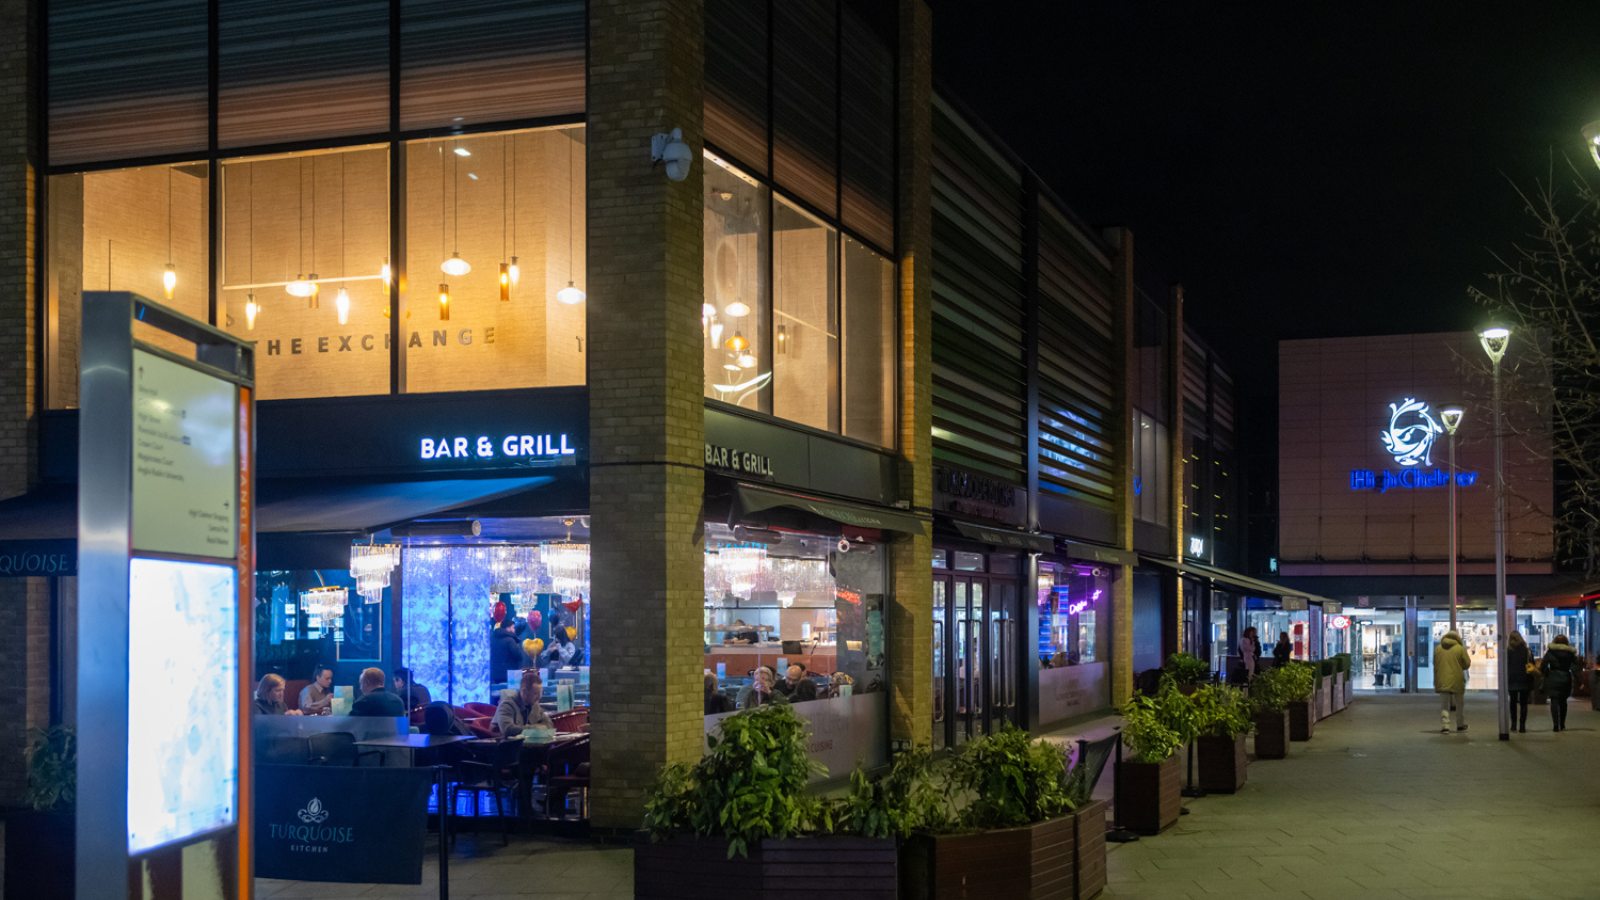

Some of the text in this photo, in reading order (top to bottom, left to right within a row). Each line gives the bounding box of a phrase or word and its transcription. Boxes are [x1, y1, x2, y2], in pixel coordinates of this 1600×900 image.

[420, 433, 575, 459] BAR & GRILL
[704, 443, 774, 476] BAR & GRILL
[1351, 469, 1398, 493] High
[268, 822, 354, 853] TURQUOISE KITCHEN
